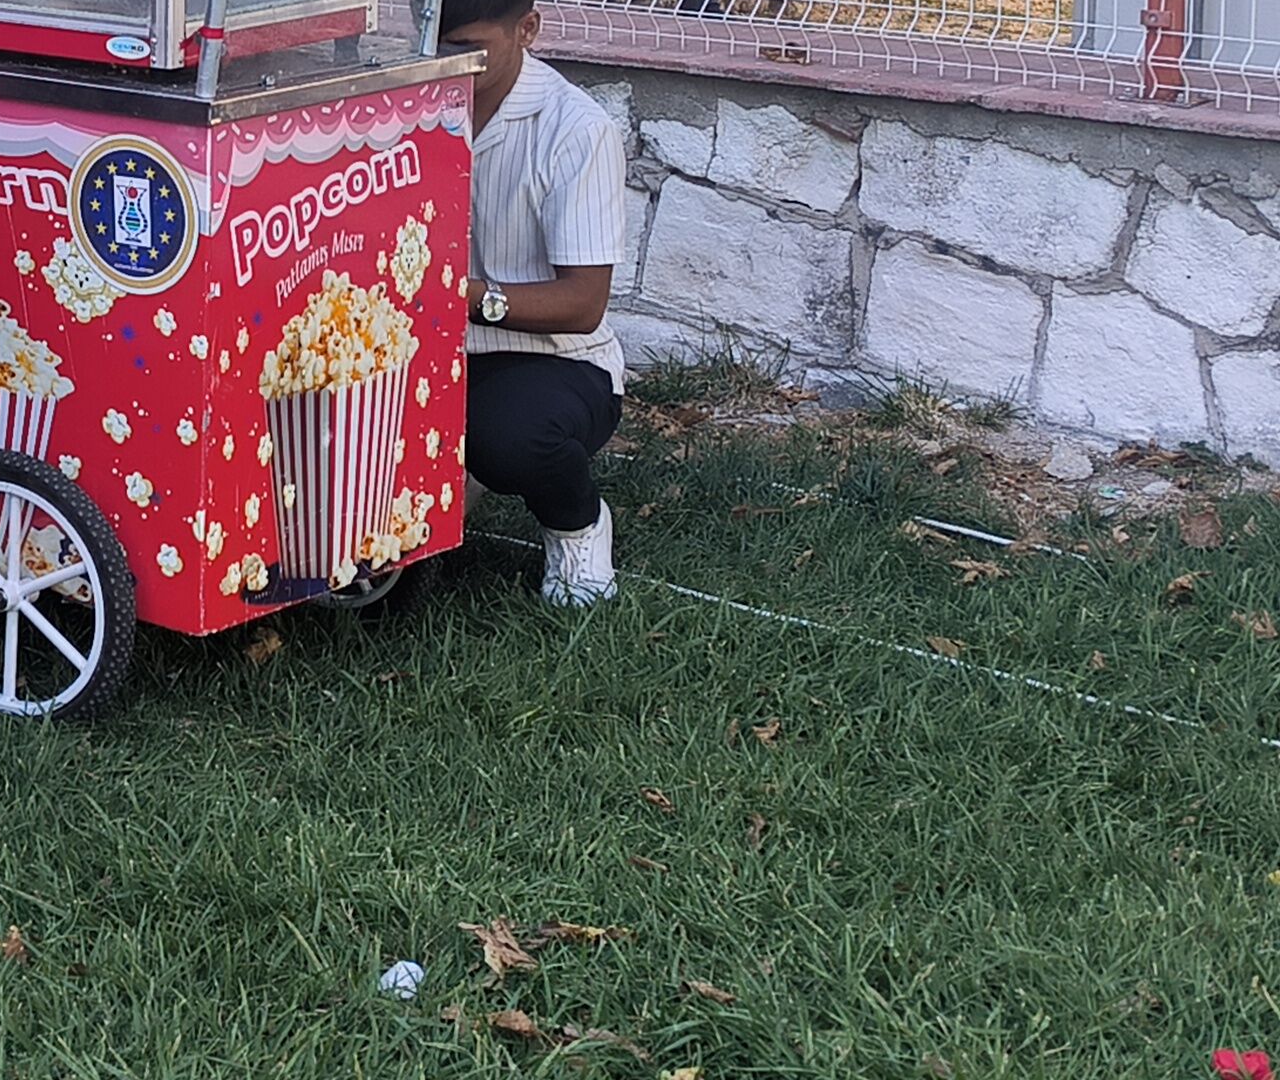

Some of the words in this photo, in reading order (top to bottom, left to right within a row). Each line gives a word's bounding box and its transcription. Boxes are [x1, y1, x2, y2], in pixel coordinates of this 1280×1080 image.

[229, 139, 422, 288] Popcorn
[275, 241, 330, 308] Patlamış
[331, 229, 365, 259] Mısır
